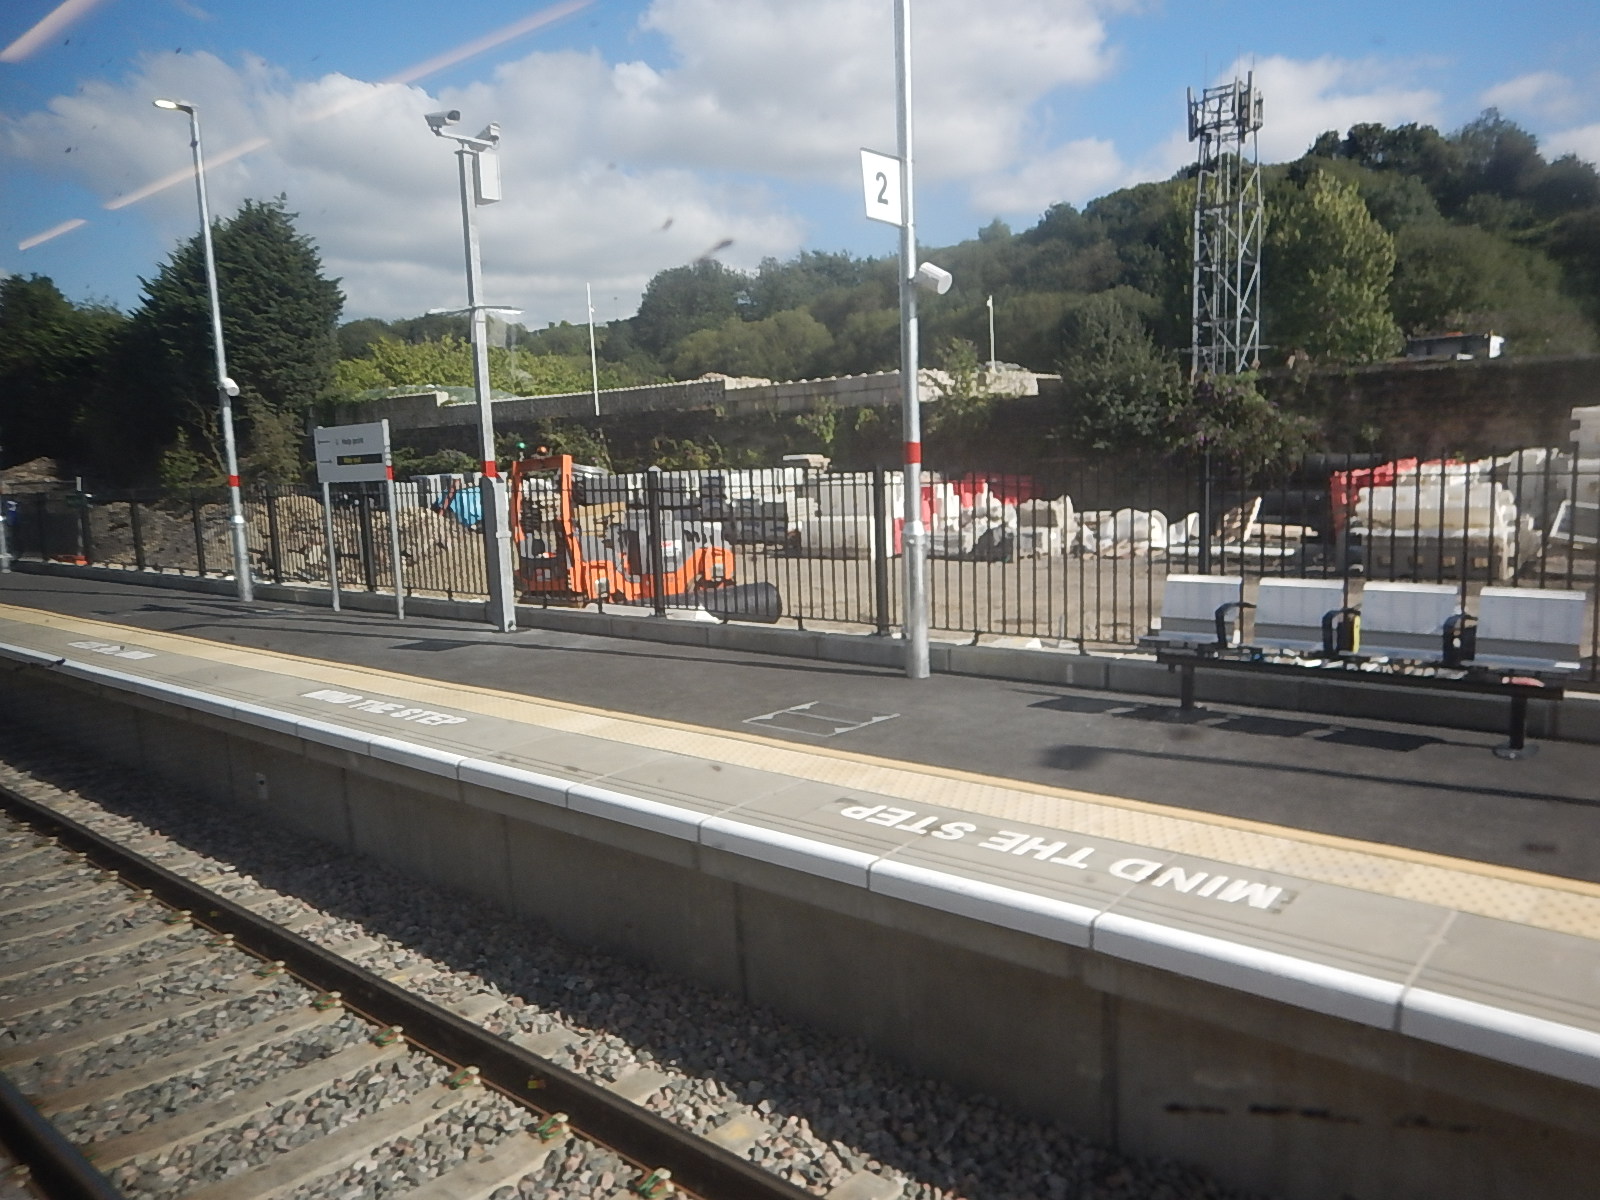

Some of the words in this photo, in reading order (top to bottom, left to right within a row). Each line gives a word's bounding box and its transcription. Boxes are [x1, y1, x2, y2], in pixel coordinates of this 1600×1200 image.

[876, 171, 889, 205] 2
[840, 804, 977, 840] STEP
[978, 830, 1096, 870] THE
[1108, 858, 1283, 910] MIND
